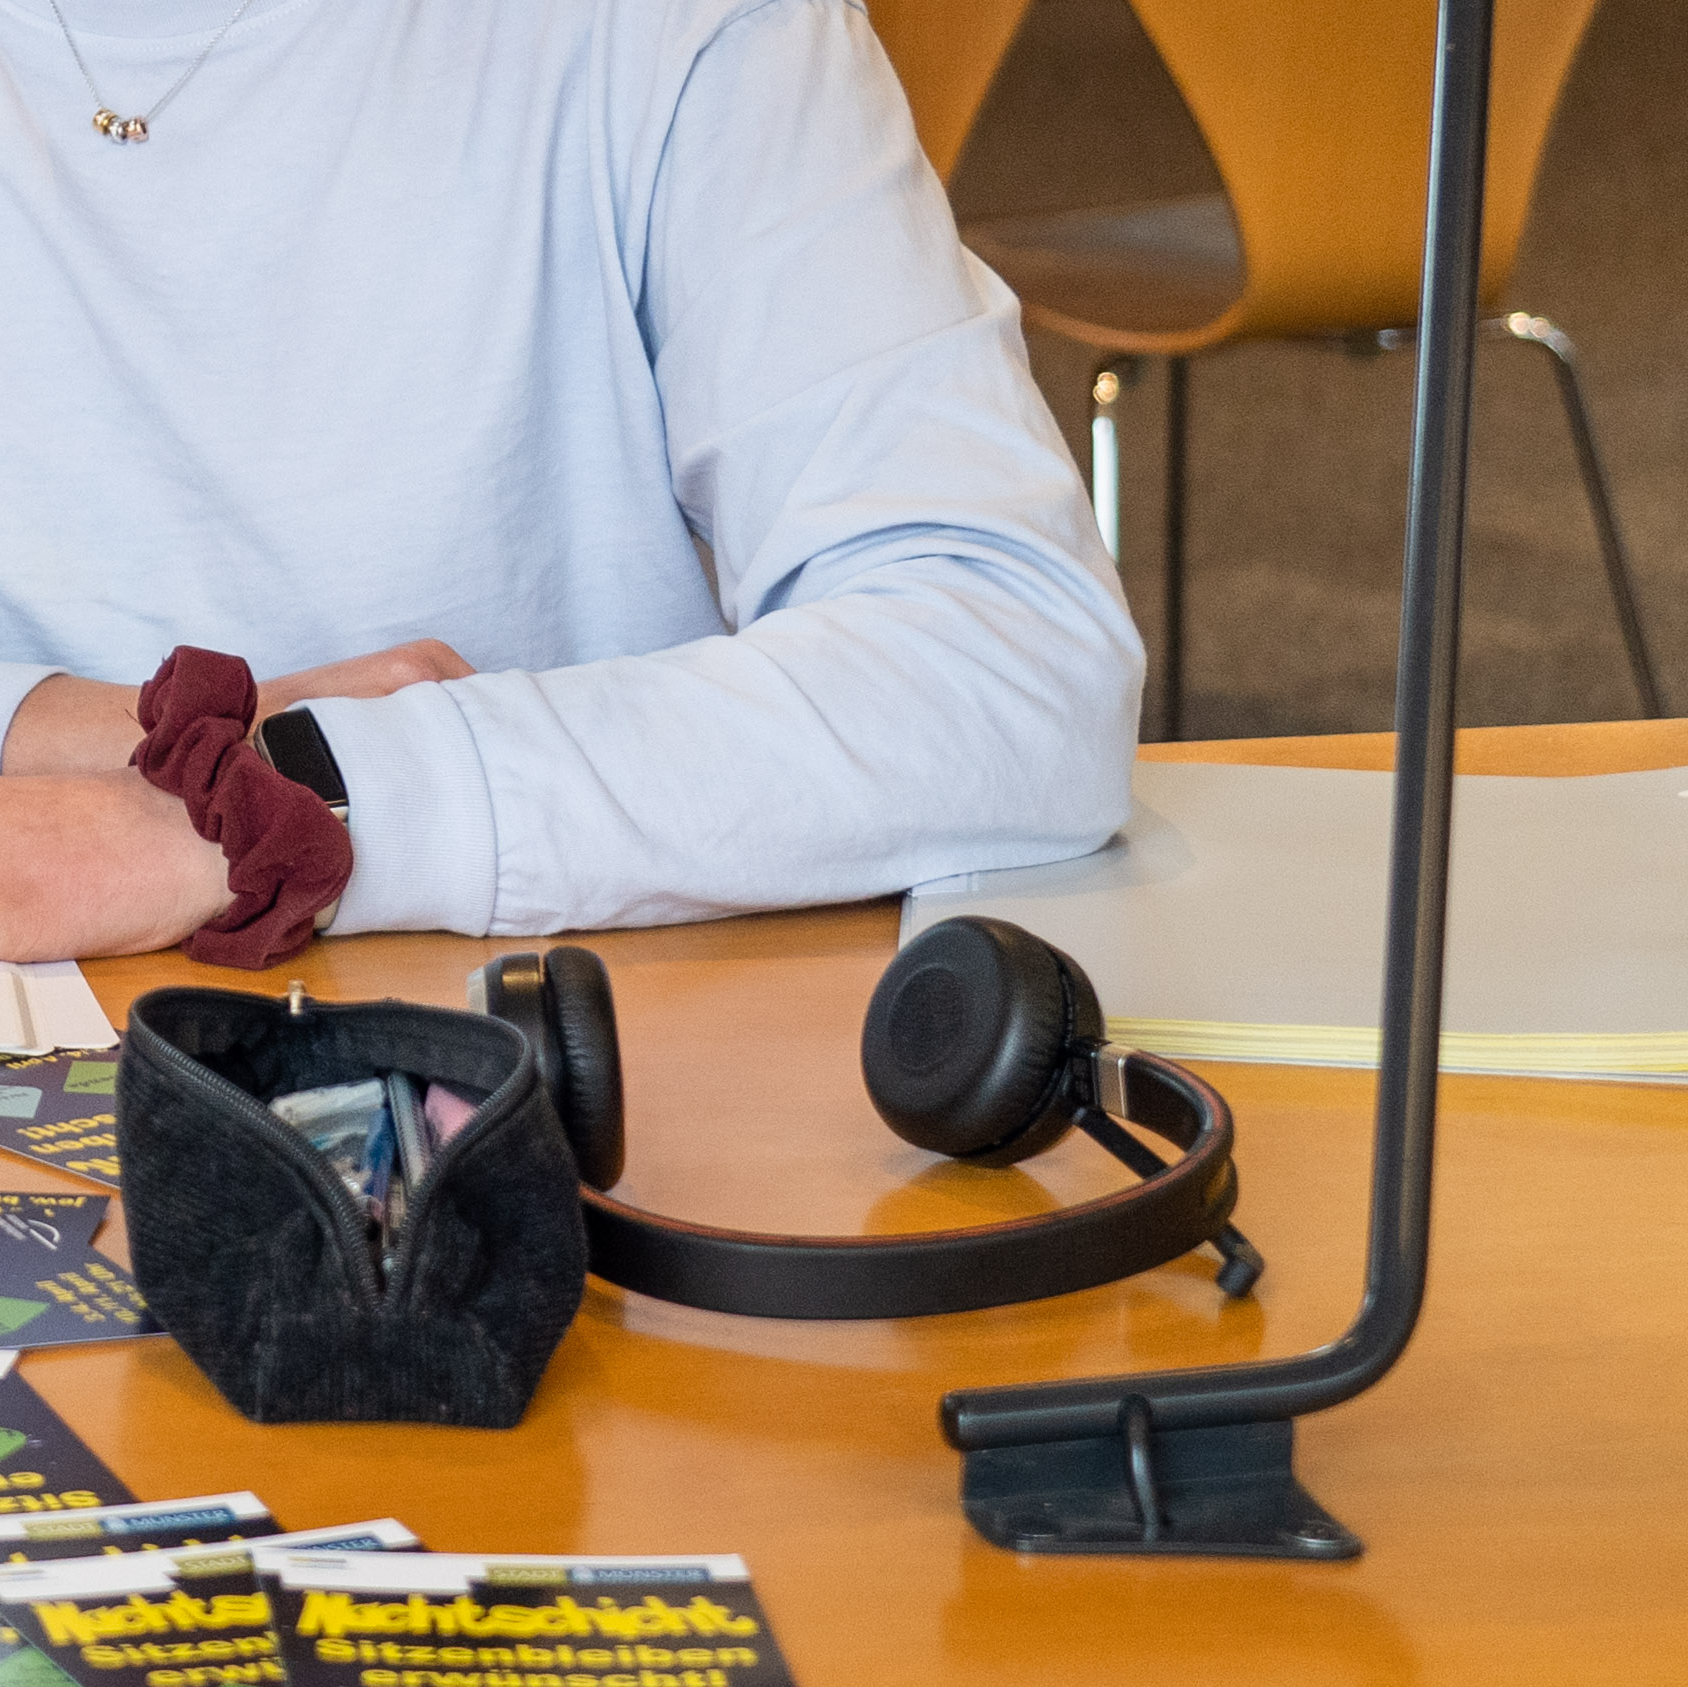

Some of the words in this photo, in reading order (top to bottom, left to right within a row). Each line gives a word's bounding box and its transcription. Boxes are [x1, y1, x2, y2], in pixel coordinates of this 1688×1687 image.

[32, 1522, 97, 1536] STADT
[129, 1508, 229, 1527] MÜNSTER
[184, 1554, 245, 1571] STADT
[491, 1568, 561, 1579] STADT
[597, 1566, 706, 1579] MÜNSTER
[297, 1589, 758, 1640] Nachtschicht.
[315, 1637, 757, 1669] Sitzenbleiben
[359, 1667, 730, 1687] erwünscht!
